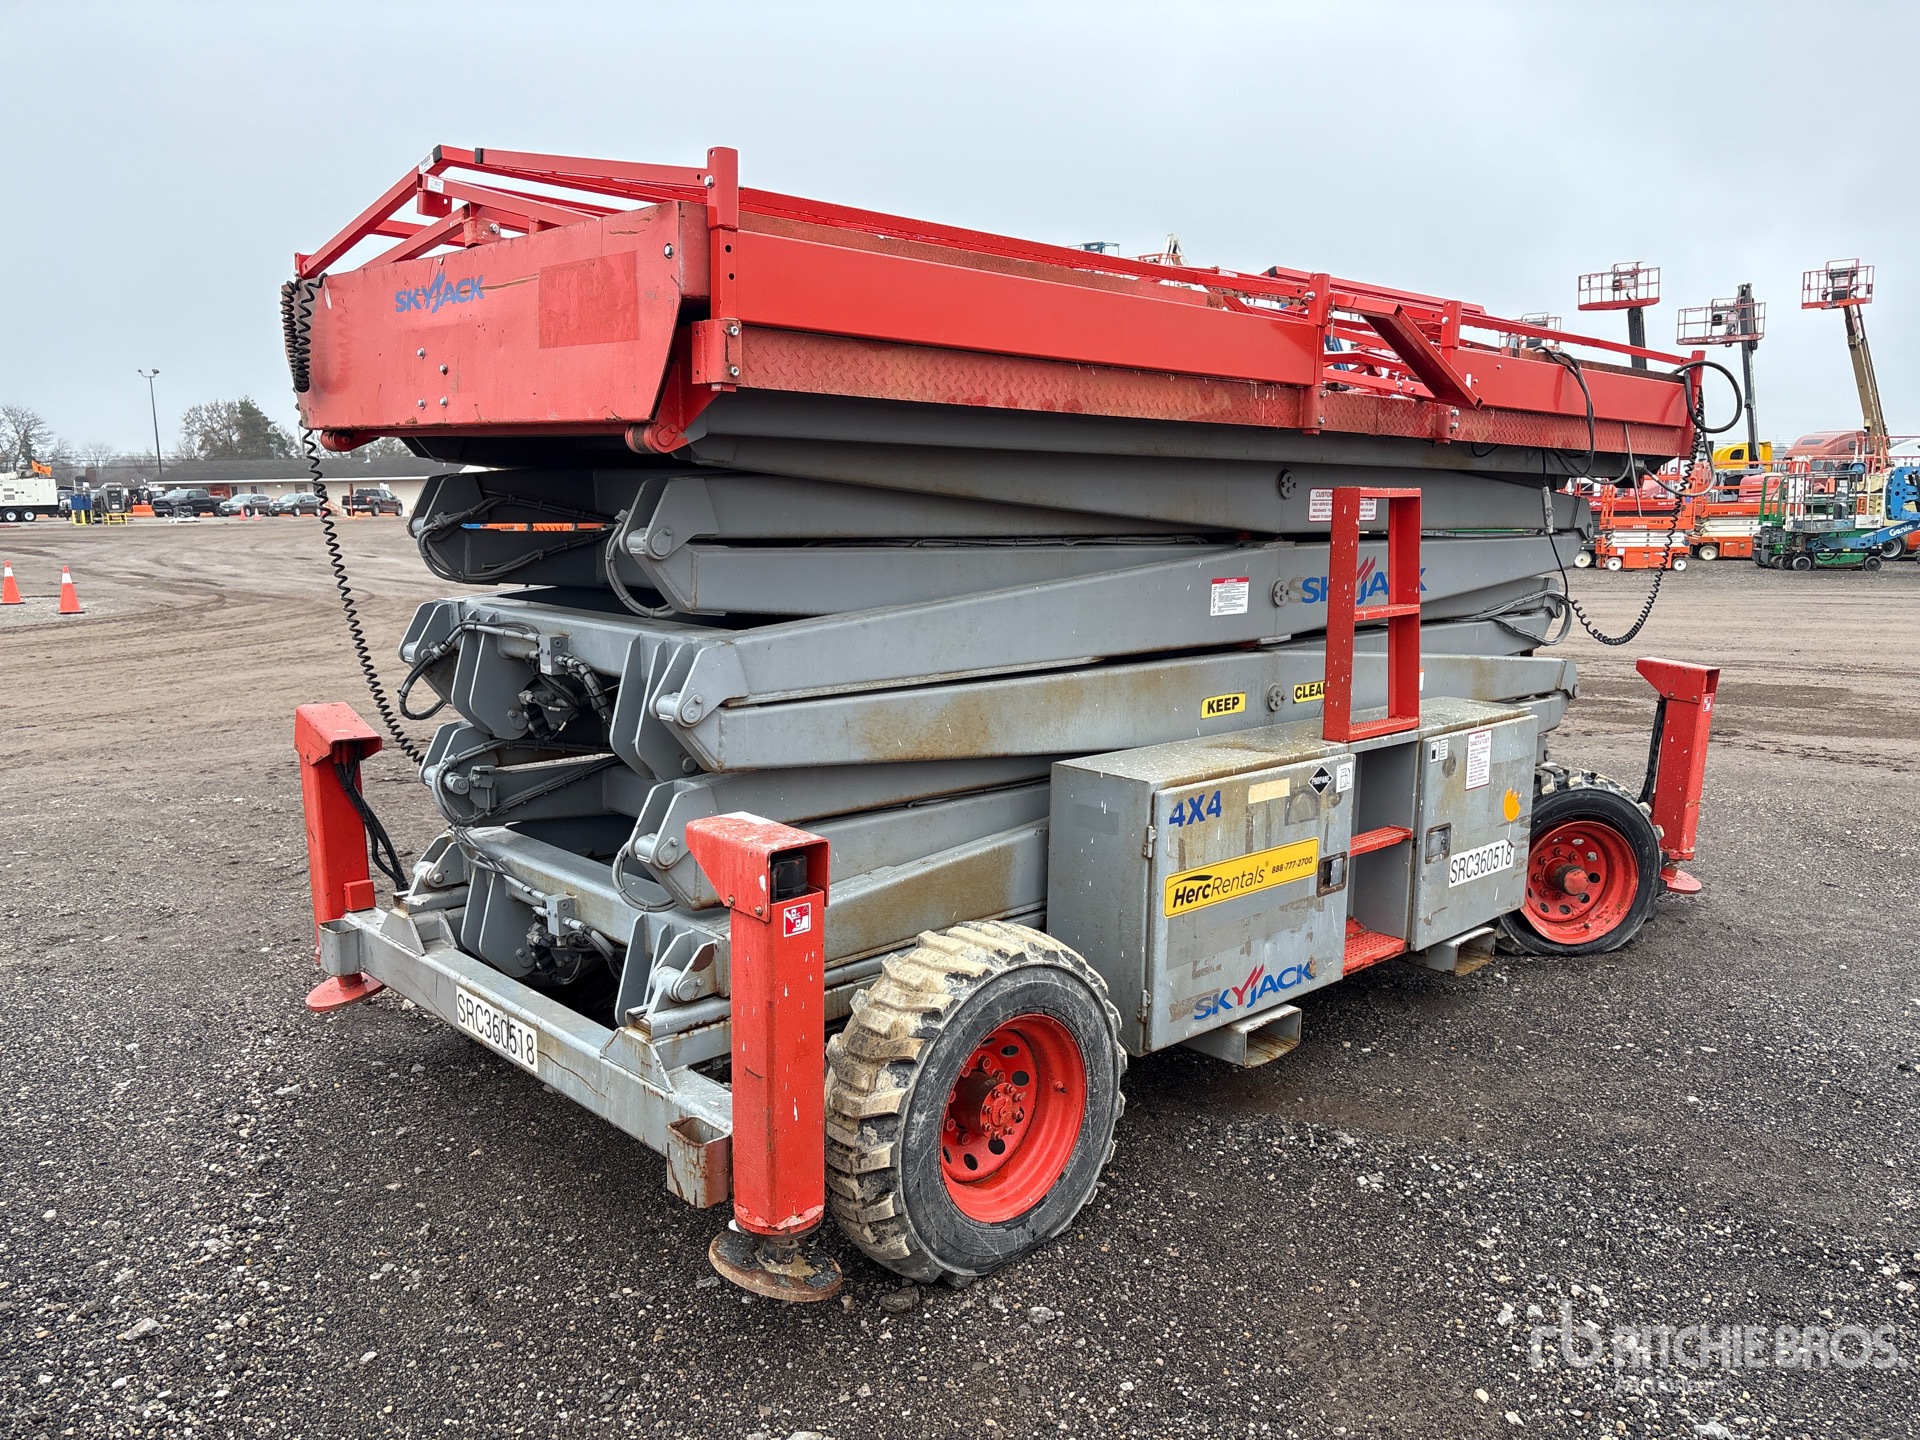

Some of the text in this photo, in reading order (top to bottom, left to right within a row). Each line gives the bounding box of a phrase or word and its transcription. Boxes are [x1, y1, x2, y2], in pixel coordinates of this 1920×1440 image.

[395, 270, 484, 314] SKYJACK
[1889, 524, 1913, 537] Genie
[1207, 696, 1240, 714] KEEP
[1311, 775, 1332, 785] PROPANE
[1169, 790, 1222, 827] 4X4
[1271, 856, 1313, 874] 888-777-2700
[1450, 842, 1512, 884] SRC360518
[1194, 963, 1316, 1020] SKYJACK
[457, 993, 534, 1065] SRC360518
